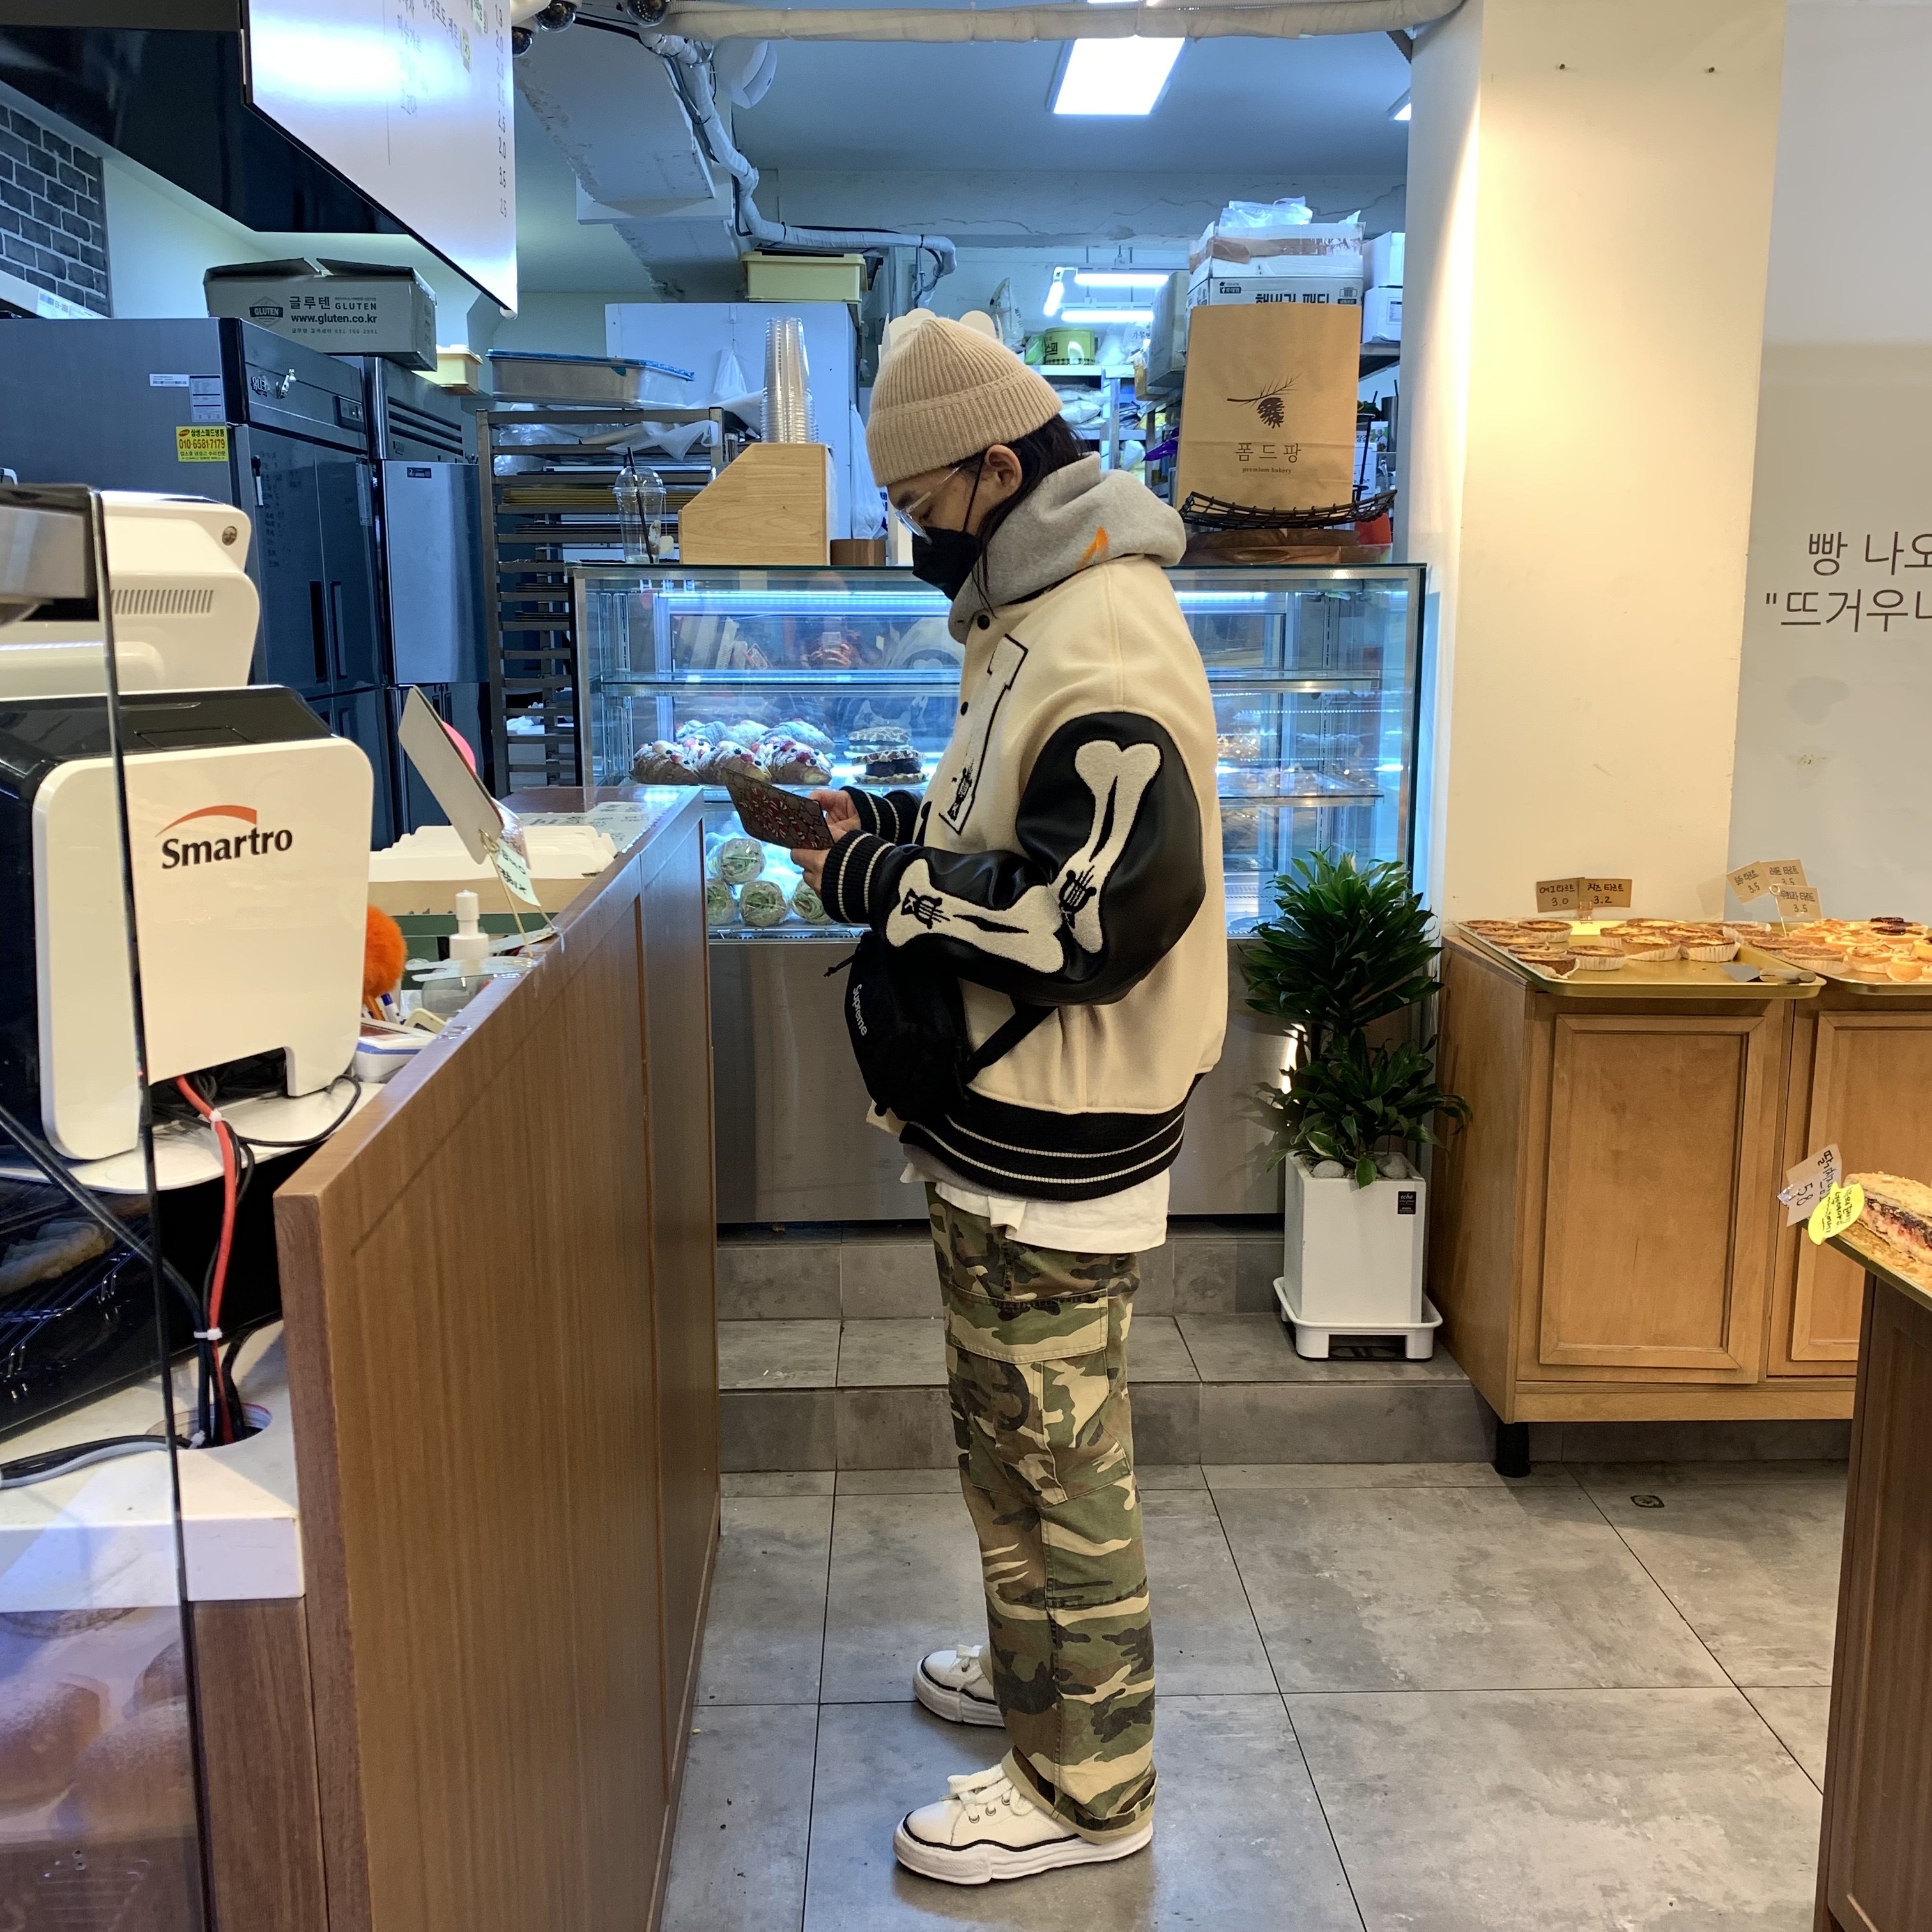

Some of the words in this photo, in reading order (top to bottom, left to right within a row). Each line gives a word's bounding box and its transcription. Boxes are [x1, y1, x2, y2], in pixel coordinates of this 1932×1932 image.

[289, 296, 330, 310] 글루텐
[335, 302, 377, 310] GLUTEN
[254, 307, 280, 317] GLUTEN
[291, 314, 377, 325] www.gluten.co.kr
[1809, 532, 1848, 576] 빵
[162, 827, 293, 870] Smartro
[1748, 882, 1760, 893] 3.5
[1552, 898, 1568, 906] 3.0
[1593, 895, 1612, 904] 3.2
[1793, 904, 1808, 912] 3.5
[852, 984, 868, 1036] Supreme
